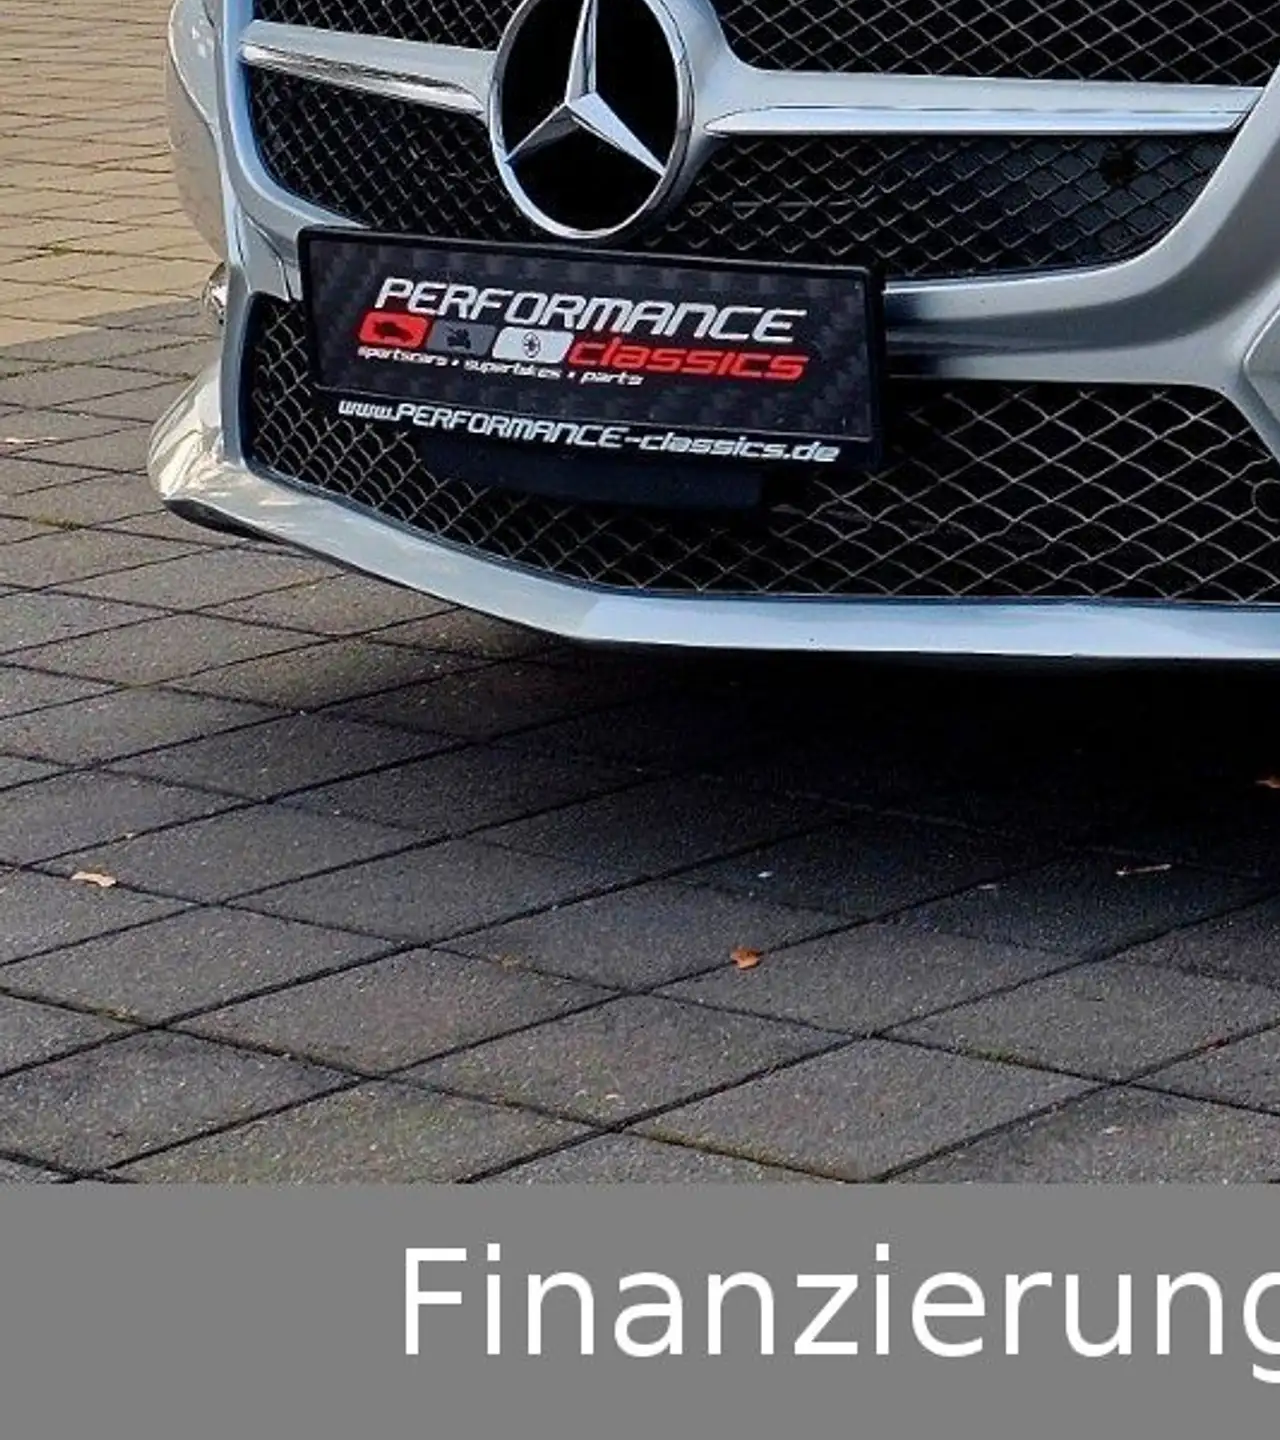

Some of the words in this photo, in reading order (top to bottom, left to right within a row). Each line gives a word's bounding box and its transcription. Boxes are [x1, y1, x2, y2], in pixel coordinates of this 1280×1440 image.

[374, 276, 807, 344] PERFORMANCE
[357, 345, 449, 367] sportscars
[463, 358, 562, 381] superbikes
[580, 369, 645, 386] parts
[567, 334, 809, 381] classics
[338, 398, 841, 463] www.PERFORMANCE-classics.de
